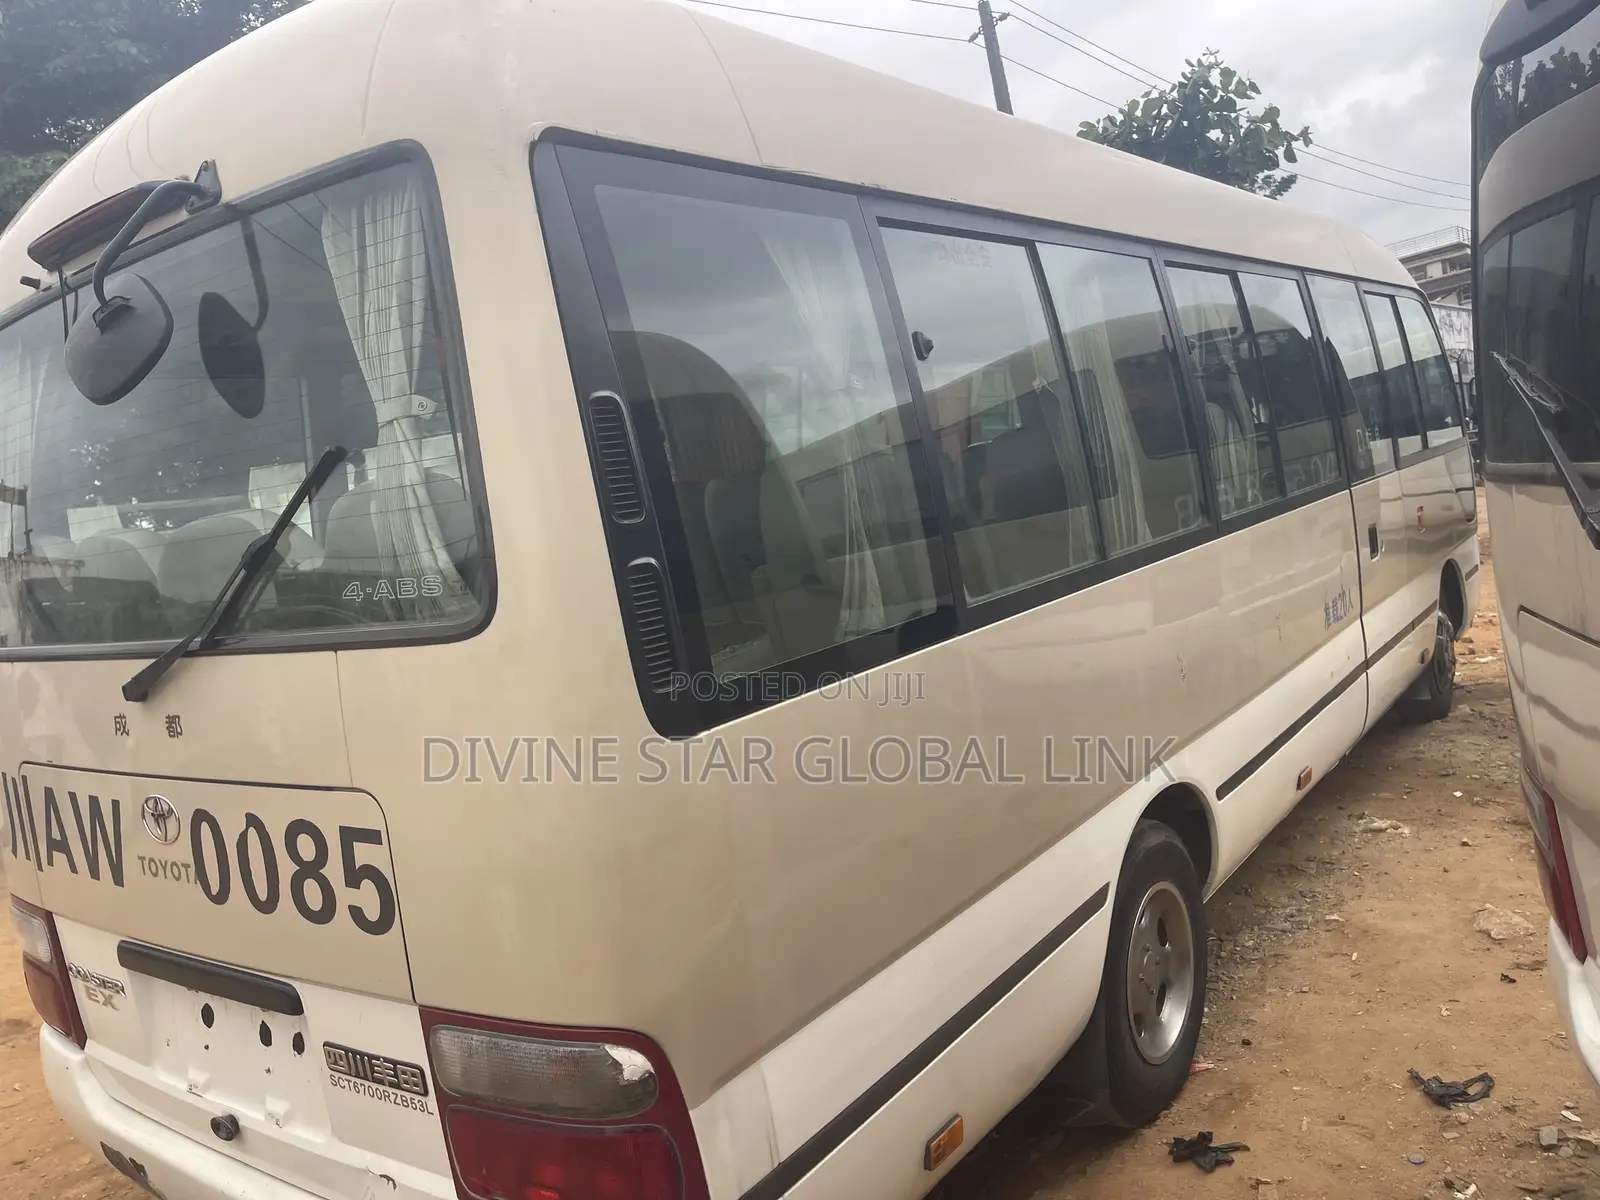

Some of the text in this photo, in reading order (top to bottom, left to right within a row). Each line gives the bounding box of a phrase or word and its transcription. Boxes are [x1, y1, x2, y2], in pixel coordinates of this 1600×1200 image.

[137, 853, 202, 885] TOYOT
[190, 808, 396, 936] 0085
[84, 984, 121, 1011] EX
[323, 1045, 426, 1095] 四川丰田
[329, 1073, 435, 1116] SCT6700RZB53L
